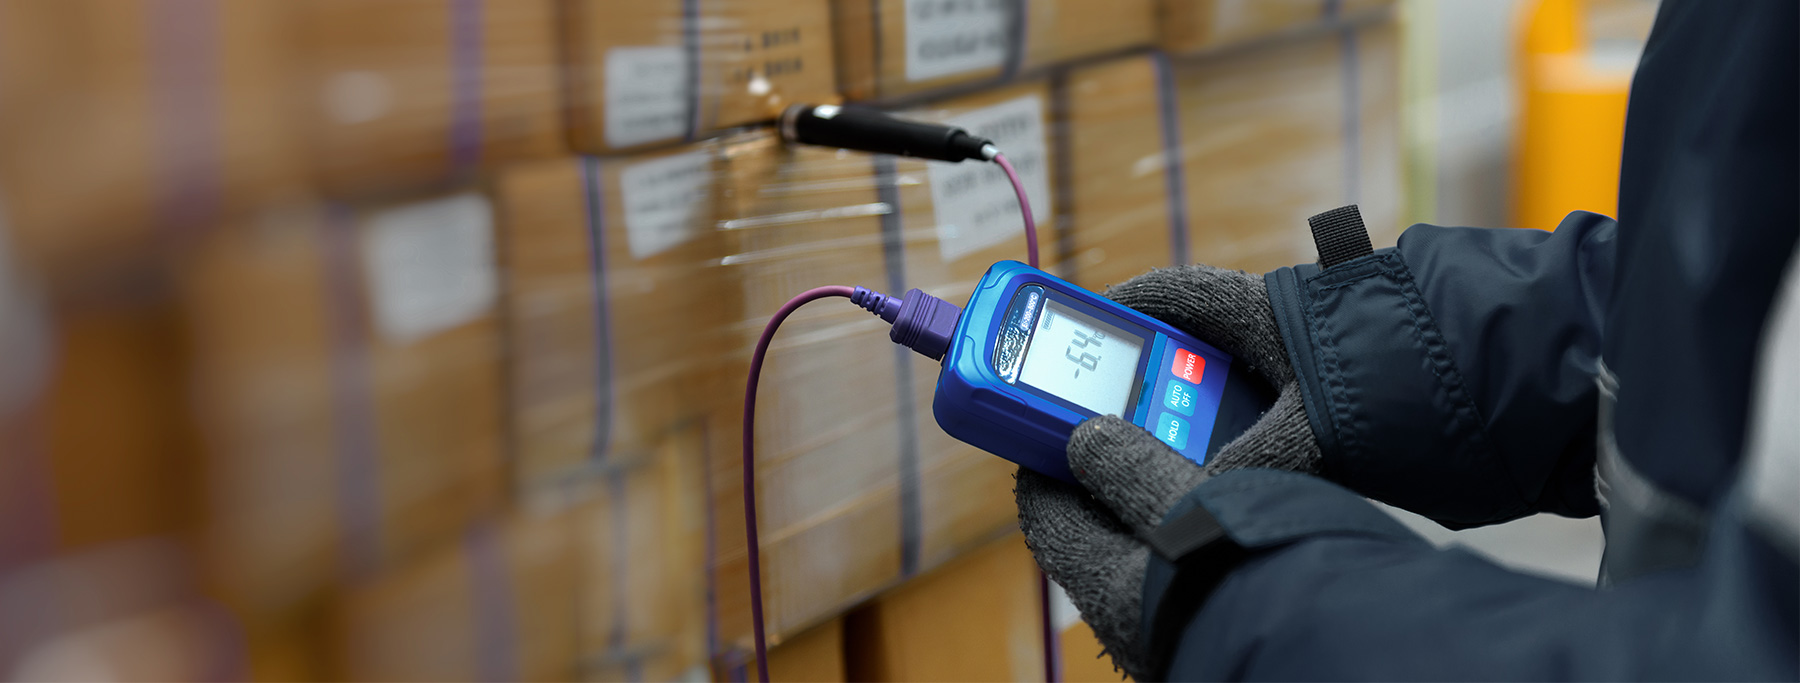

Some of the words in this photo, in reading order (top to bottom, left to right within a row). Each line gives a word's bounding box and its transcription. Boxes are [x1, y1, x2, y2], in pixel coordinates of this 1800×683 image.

[1183, 353, 1196, 380] POWER
[1170, 384, 1182, 407] AUTO
[1181, 391, 1191, 407] OFF
[1167, 420, 1180, 442] HOLD
